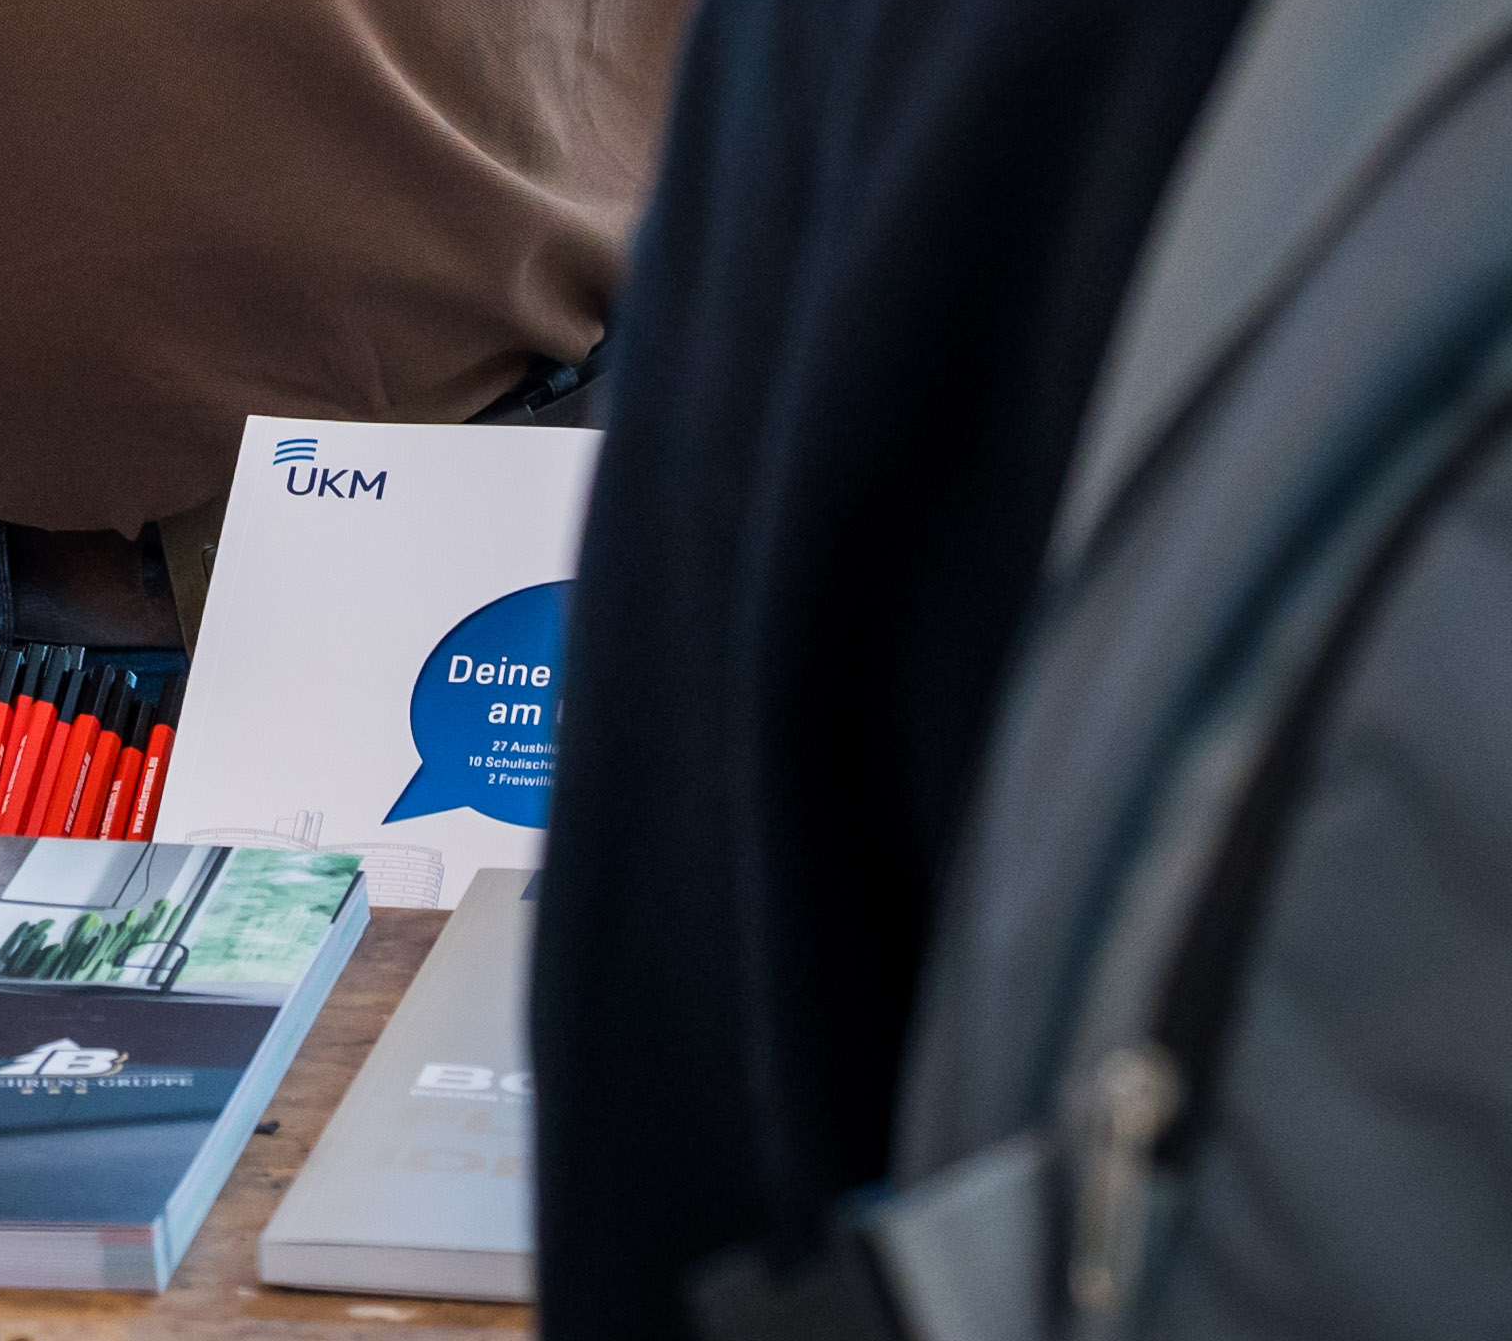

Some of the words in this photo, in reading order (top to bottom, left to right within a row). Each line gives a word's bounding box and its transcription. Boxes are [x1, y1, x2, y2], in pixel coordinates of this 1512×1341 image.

[287, 466, 388, 500] UKM
[448, 654, 551, 687] Deine
[488, 701, 542, 726] am
[492, 740, 508, 752] 27
[469, 755, 482, 767] 10
[488, 773, 496, 785] 2
[499, 773, 554, 787] Freiwilli
